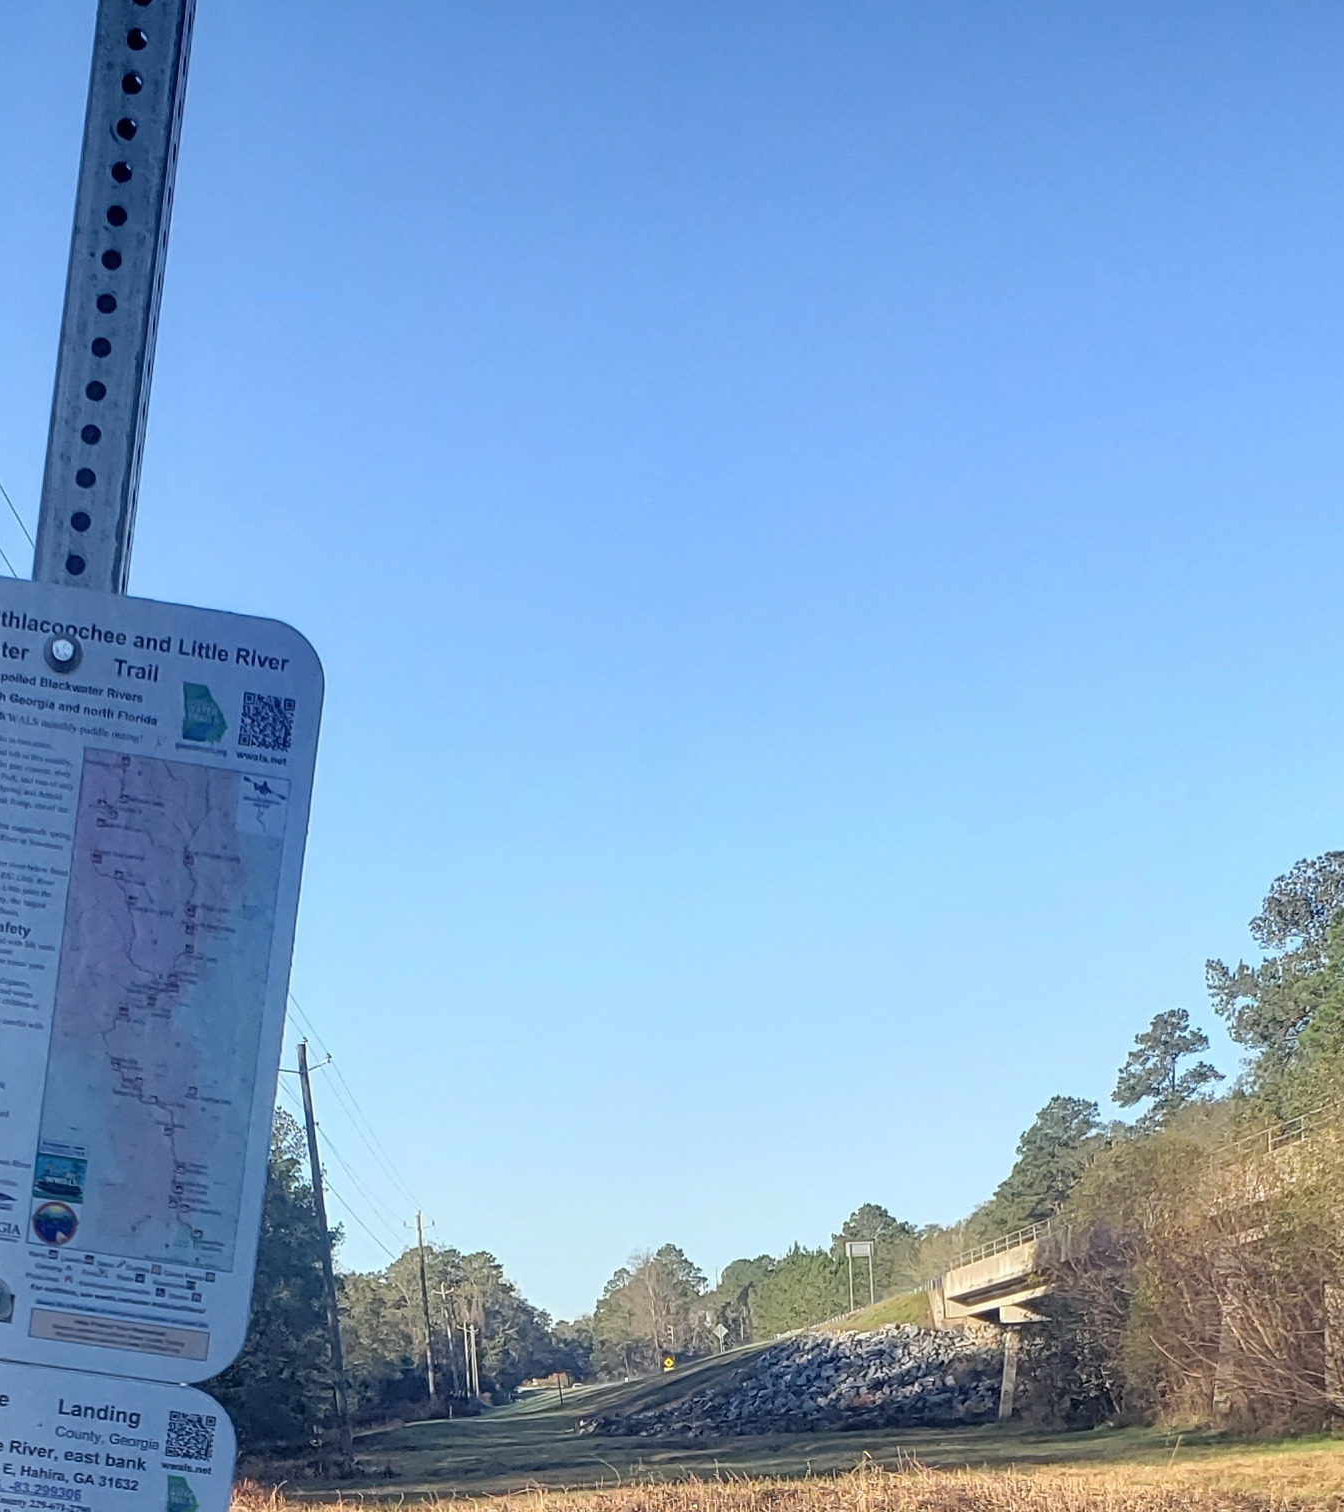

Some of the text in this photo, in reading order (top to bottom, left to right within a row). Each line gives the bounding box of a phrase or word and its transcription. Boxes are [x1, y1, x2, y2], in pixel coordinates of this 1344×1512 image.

[133, 635, 172, 653] and
[178, 637, 229, 661] Little
[236, 647, 290, 672] River
[114, 658, 159, 682] Trail
[39, 678, 103, 697] Blackwater
[107, 687, 143, 703] Rivers
[10, 692, 54, 710] Georgia
[58, 702, 79, 714] and
[83, 706, 114, 720] north
[118, 710, 158, 726] Florida
[237, 751, 288, 767] wwals.net
[58, 1398, 141, 1429] Landing
[55, 1425, 105, 1445] County,
[109, 1433, 160, 1451] Georgia
[8, 1440, 59, 1462] River,
[64, 1450, 101, 1466] east
[105, 1453, 146, 1471] bank
[161, 1462, 212, 1475] wwals.net
[3, 1463, 16, 1477] E,
[20, 1464, 69, 1483] Hahira,
[73, 1472, 95, 1486] GA
[98, 1475, 140, 1491] 31632
[9, 1480, 83, 1501] -83.299306
